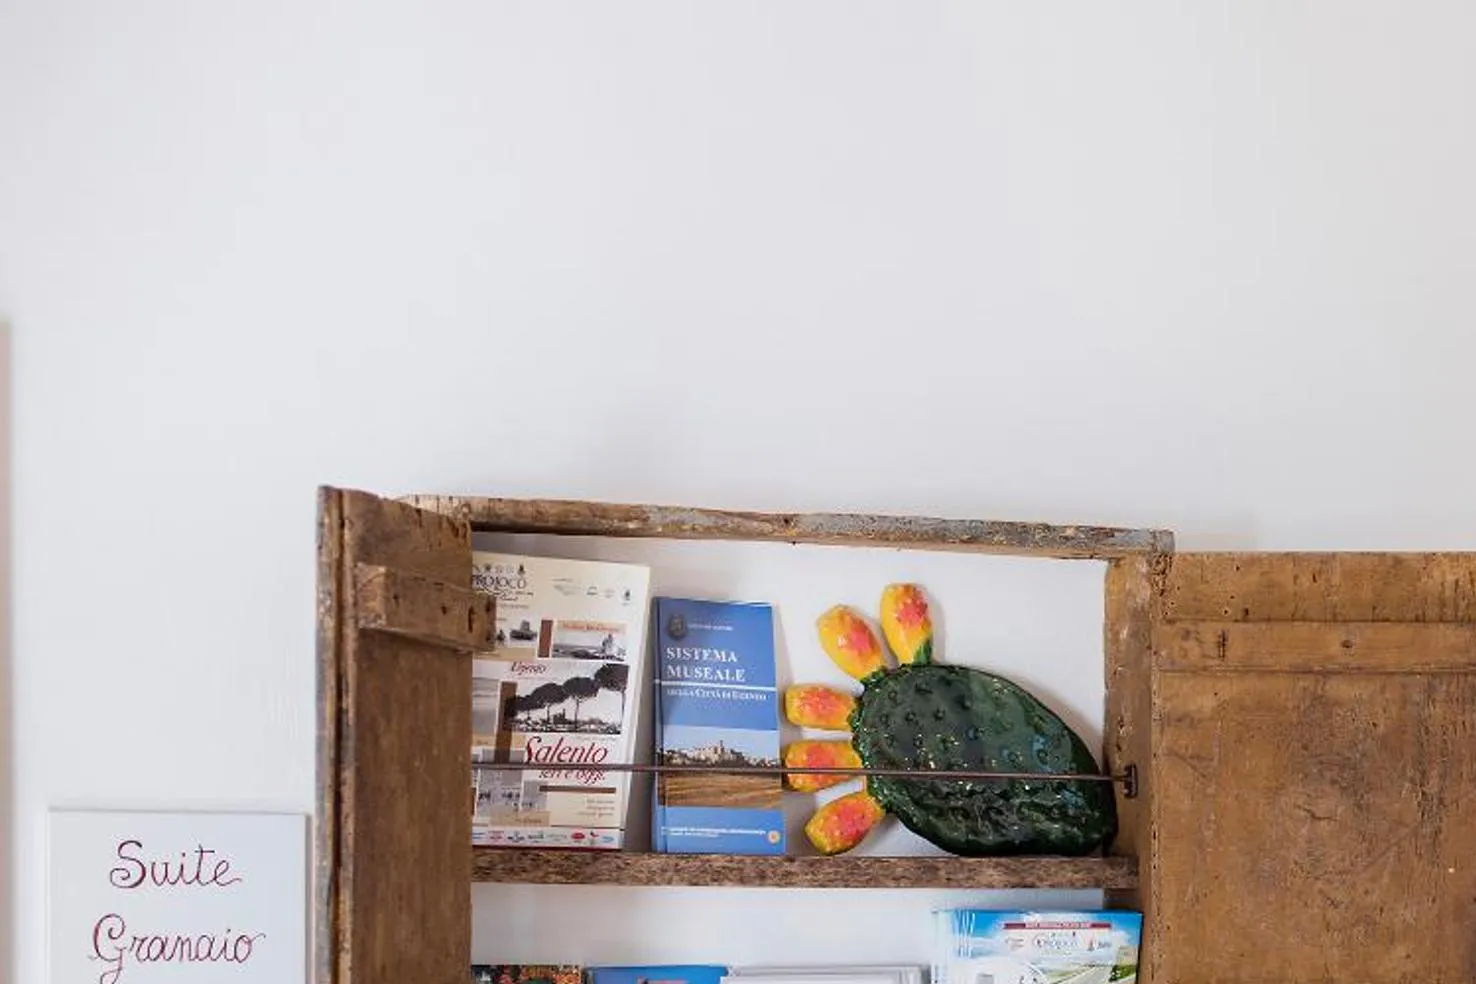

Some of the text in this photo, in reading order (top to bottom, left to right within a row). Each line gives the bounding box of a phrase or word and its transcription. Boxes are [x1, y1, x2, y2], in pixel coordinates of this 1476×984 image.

[666, 647, 738, 662] SISTEMA
[667, 665, 745, 682] MUSEALE
[525, 735, 608, 763] Salento
[109, 839, 243, 889] Suite
